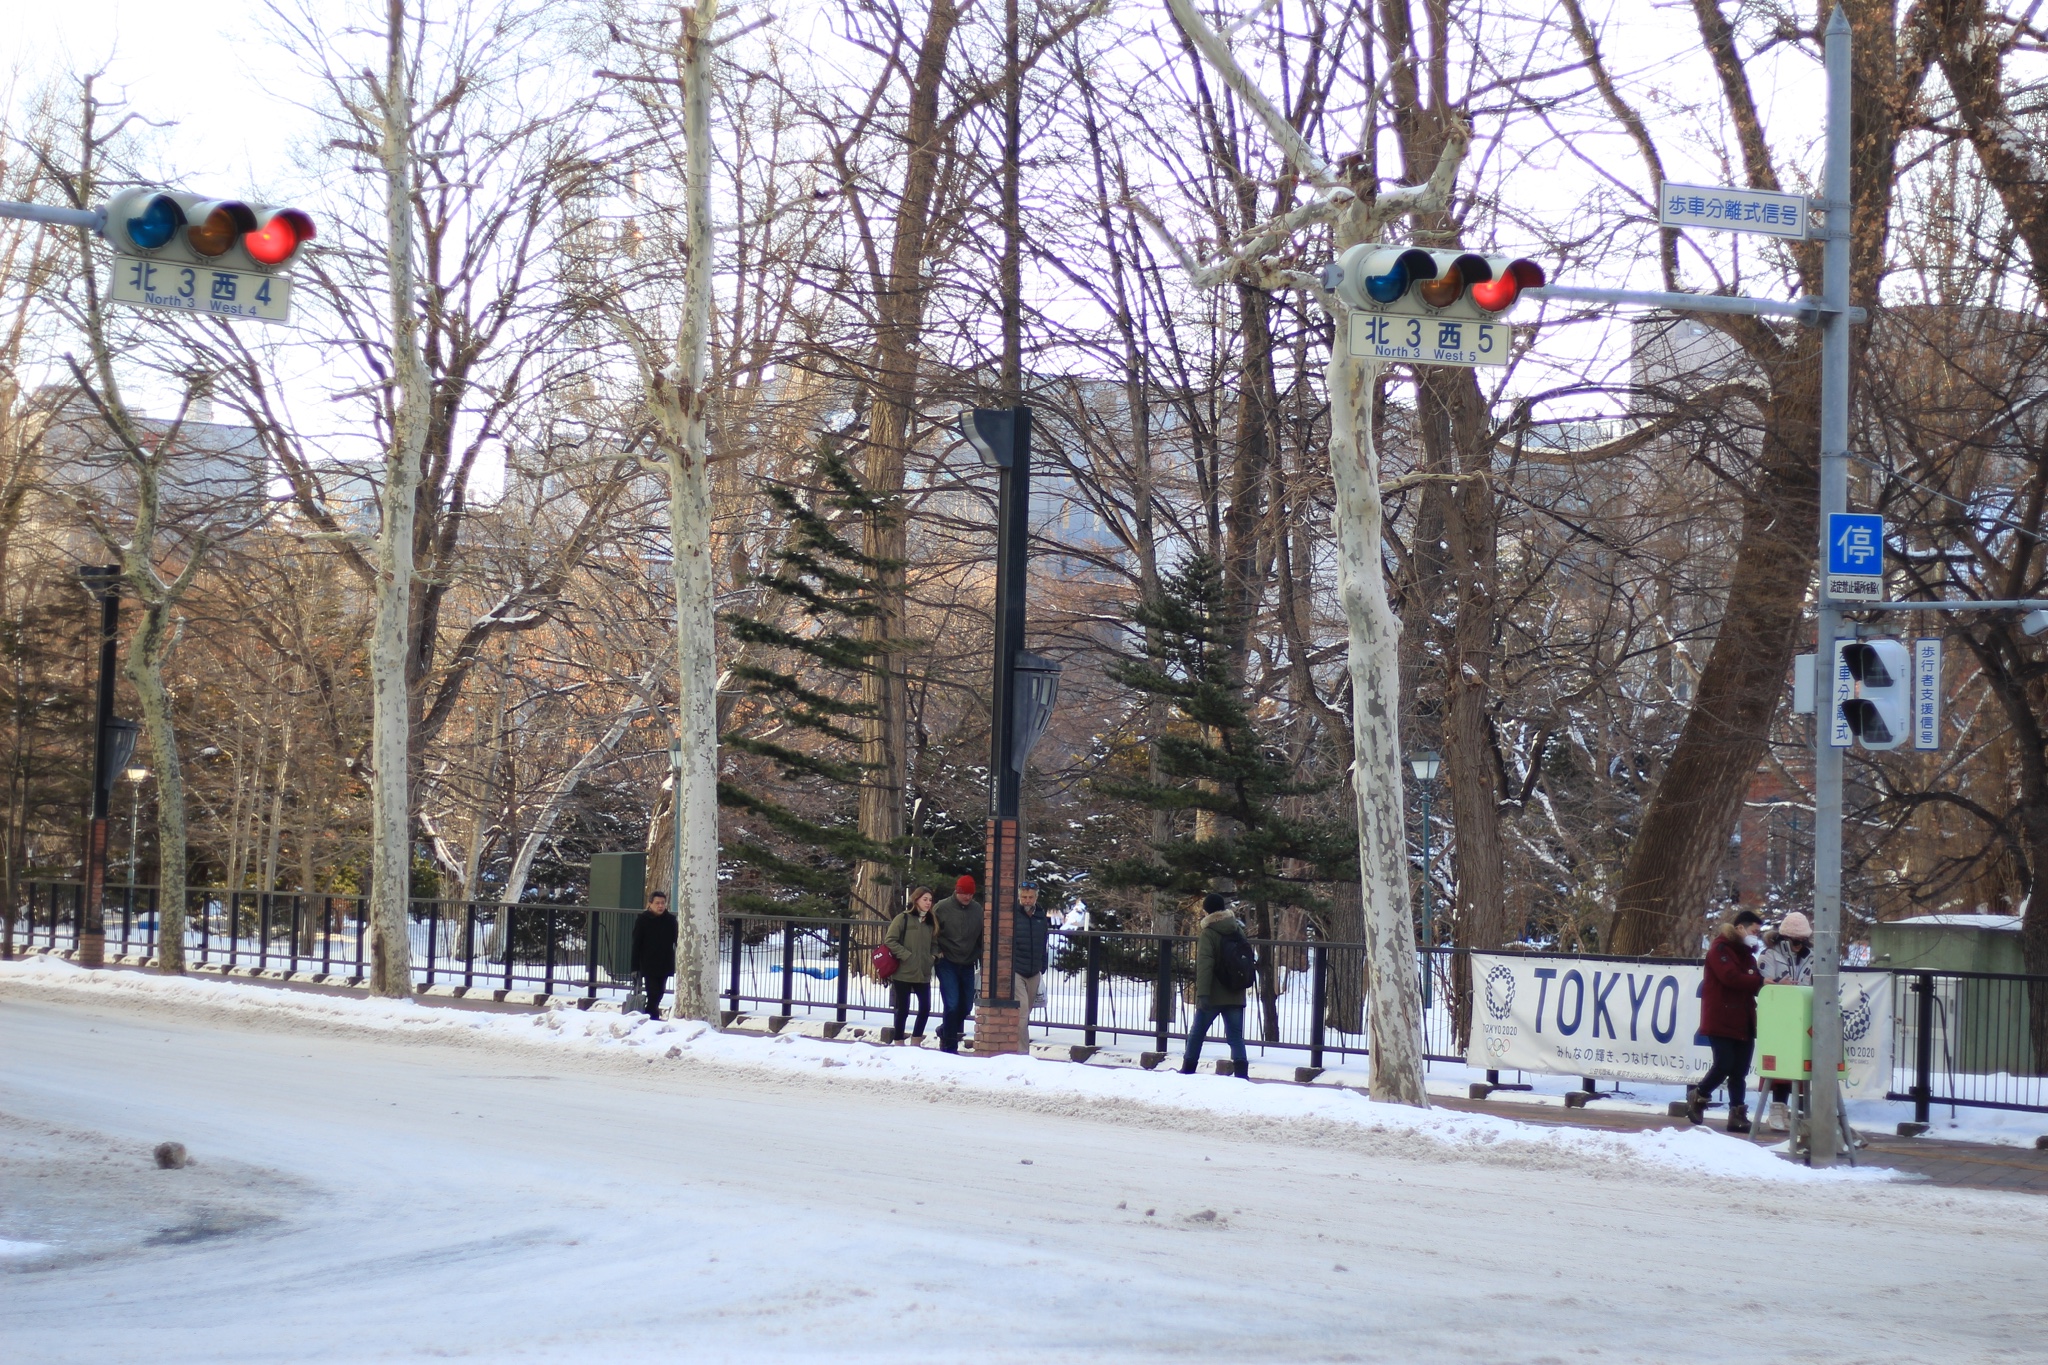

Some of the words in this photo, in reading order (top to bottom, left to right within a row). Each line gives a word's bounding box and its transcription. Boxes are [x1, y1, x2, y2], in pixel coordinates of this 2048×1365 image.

[1668, 195, 1798, 226] 歩車分離式信号
[145, 292, 181, 307] North
[187, 298, 195, 308] 3
[209, 300, 242, 314] West
[248, 305, 257, 316] 4
[1375, 345, 1408, 357] North
[1413, 348, 1421, 358] 3
[1434, 349, 1463, 361] West
[1469, 352, 1476, 362] 5
[1837, 525, 1874, 564] 停
[1920, 646, 1935, 744] 歩行者支援信号
[1534, 967, 1679, 1044] TOKYO
[1482, 1023, 1501, 1035] TOKYO
[1502, 1025, 1518, 1036] 2020
[1857, 1046, 1875, 1058] 2020
